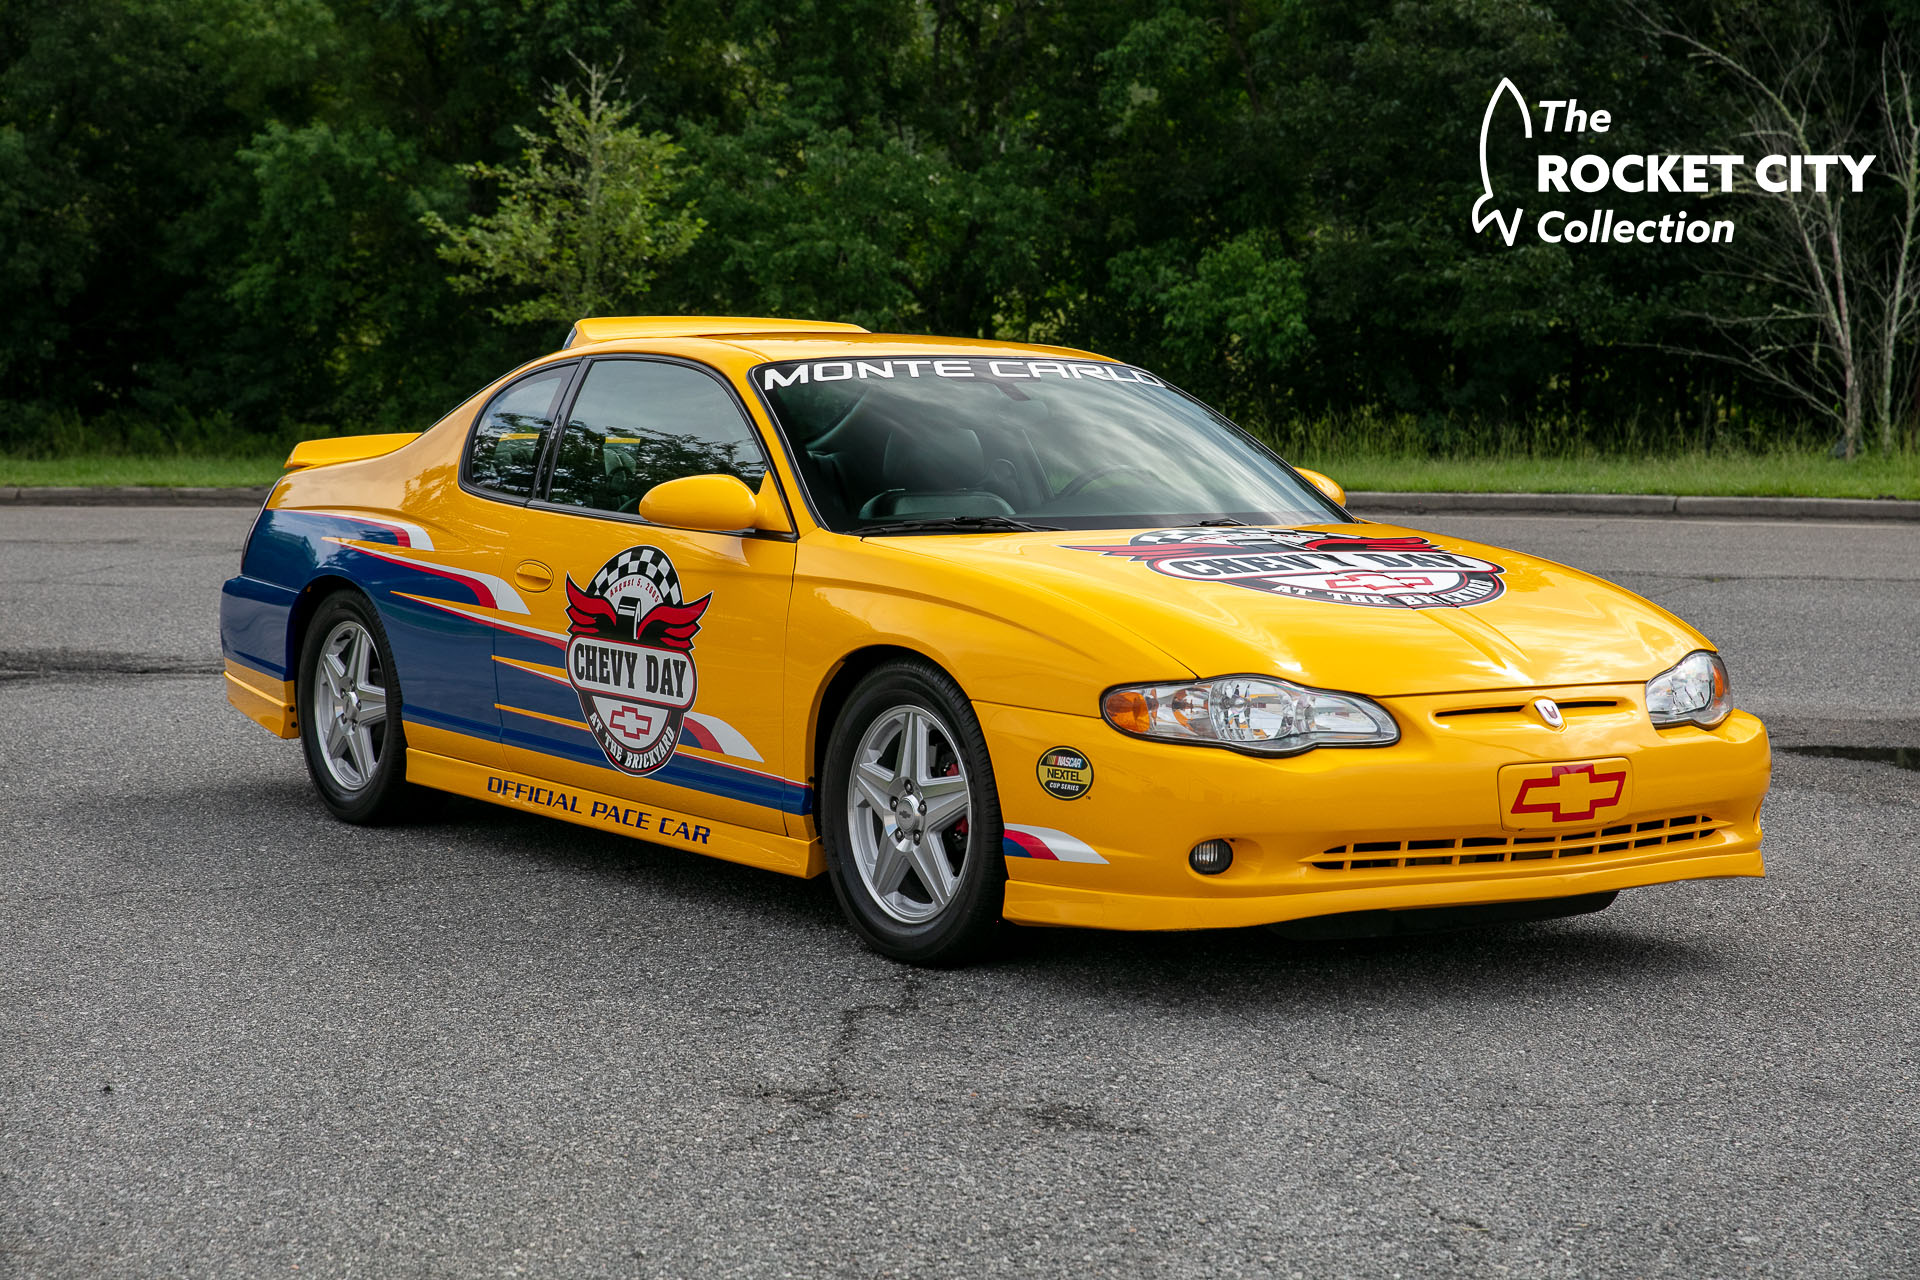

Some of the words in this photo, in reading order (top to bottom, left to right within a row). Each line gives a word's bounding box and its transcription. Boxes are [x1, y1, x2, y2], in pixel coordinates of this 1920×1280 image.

[764, 360, 975, 391] MONTE
[993, 361, 1166, 388] CARLO
[1169, 554, 1355, 576] CHEVY
[1355, 553, 1475, 568] DAY
[1272, 585, 1312, 596] AT
[1327, 591, 1391, 605] THE
[573, 643, 638, 690] CHEVY
[645, 654, 687, 698] DAY
[590, 712, 603, 733] AT
[604, 732, 623, 762] THE
[624, 726, 676, 769] BRICKYARD
[1057, 756, 1082, 768] NASCAR
[1047, 768, 1083, 782] NEXTEL
[1061, 783, 1079, 791] SERIES
[487, 776, 583, 815] OFFICIAL
[590, 801, 652, 830] PACE
[658, 817, 712, 845] CAR
